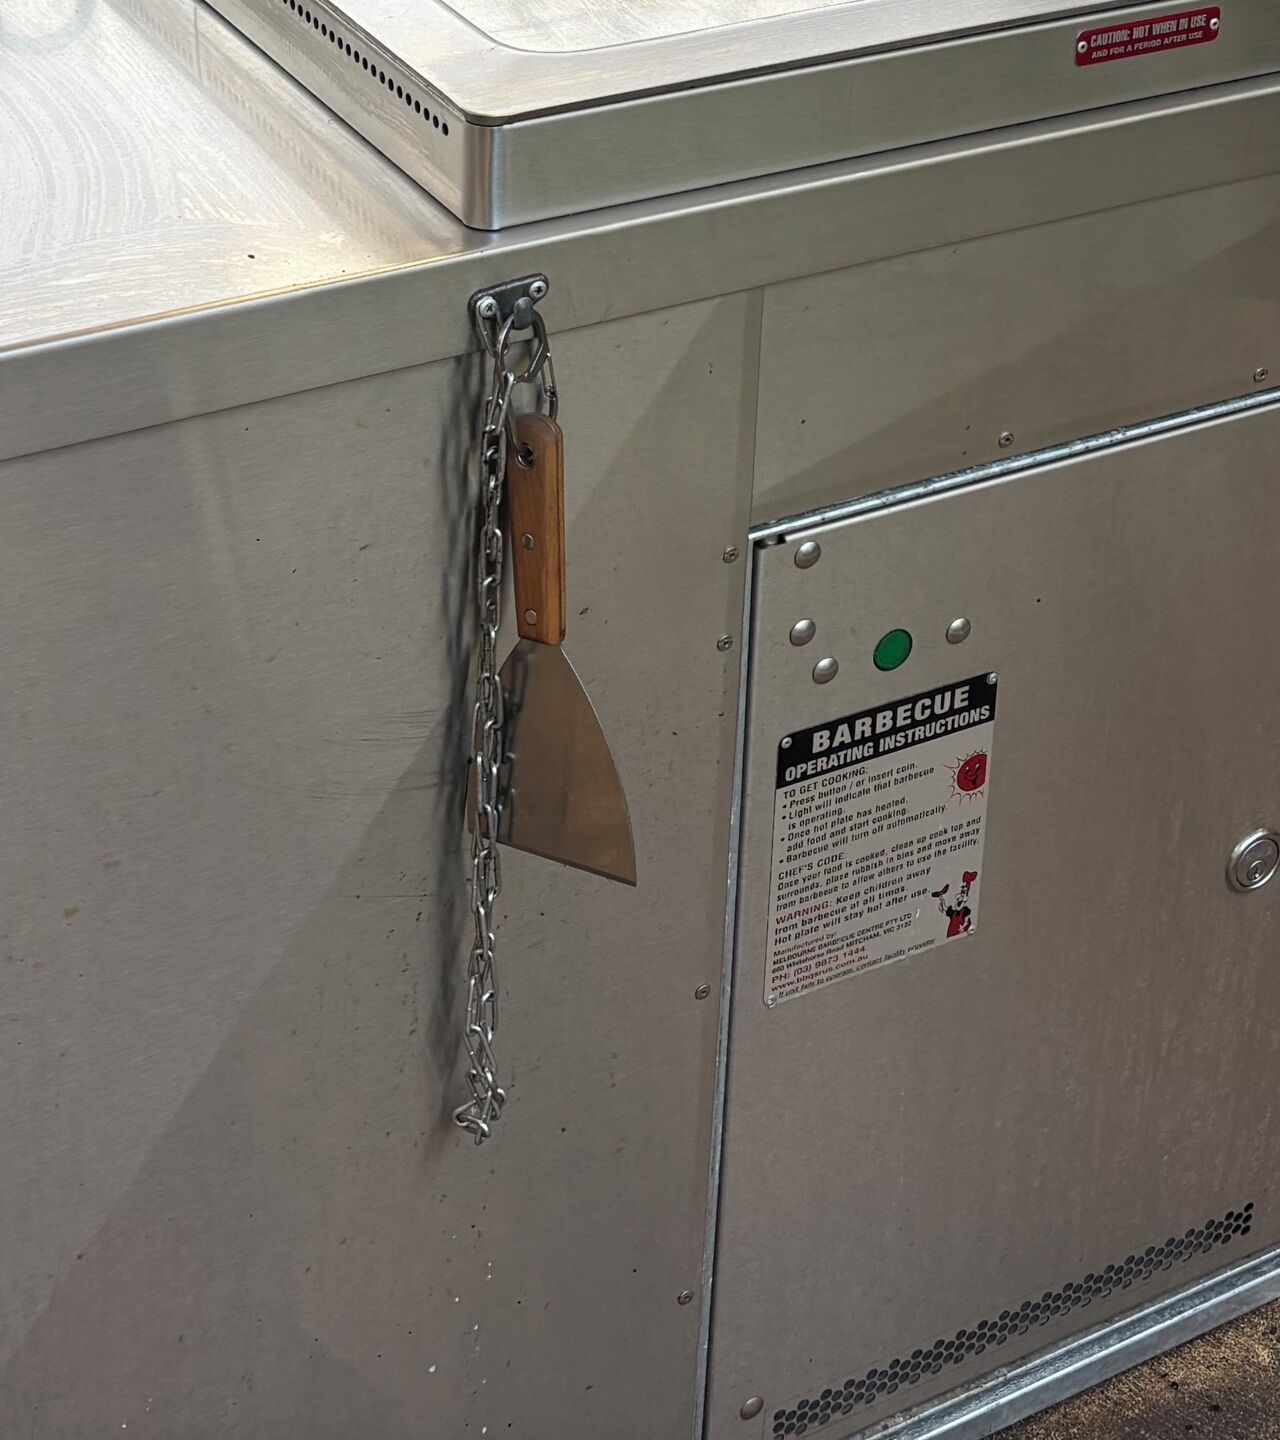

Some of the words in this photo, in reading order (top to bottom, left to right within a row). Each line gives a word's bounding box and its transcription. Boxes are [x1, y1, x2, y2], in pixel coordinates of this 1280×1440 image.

[1090, 29, 1131, 48] CAUTION:
[1132, 24, 1151, 39] HOT
[1152, 20, 1177, 35] WHEN
[1178, 17, 1190, 30] IN
[1190, 13, 1208, 28] USE
[1091, 49, 1108, 59] AND
[1109, 46, 1125, 56] FOR
[1126, 44, 1133, 52] A
[1134, 38, 1162, 51] PERIOD
[1163, 34, 1187, 45] AFTER
[1188, 30, 1204, 40] USE
[812, 685, 970, 754] BARBECUE
[785, 742, 874, 782] OPERATING
[879, 704, 991, 753] INSTRUCTIONS
[783, 789, 795, 799] TO
[799, 781, 818, 794] GET
[821, 765, 868, 788] COOKING:
[789, 793, 814, 809] Press
[818, 783, 846, 799] button
[856, 779, 864, 787] or
[868, 768, 893, 783] insert
[789, 805, 811, 820] Light
[815, 799, 831, 811] will
[835, 786, 870, 804] indicate
[874, 779, 890, 791] that
[894, 765, 934, 785] barbecue
[786, 842, 828, 863] Barbecue
[832, 836, 847, 847] will
[852, 829, 868, 841] turn
[872, 825, 883, 834] off
[787, 840, 803, 852] add
[807, 833, 826, 845] food
[830, 826, 845, 838] and
[849, 819, 868, 831] start
[788, 827, 809, 841] Once
[814, 822, 827, 832] hot
[831, 813, 853, 828] plate
[856, 807, 871, 818] has
[788, 821, 795, 830] is
[778, 877, 798, 891] Once
[802, 871, 820, 883] your
[824, 863, 841, 875] food
[845, 859, 852, 867] is
[891, 839, 913, 852] clean
[917, 835, 926, 844] up
[929, 827, 947, 839] cook
[951, 822, 963, 833] top
[966, 816, 980, 827] and
[778, 862, 813, 880] CHEF'S
[826, 871, 848, 885] place
[852, 859, 883, 876] rubbish
[886, 856, 893, 864] in
[896, 849, 913, 861] bins
[917, 843, 931, 853] and
[935, 835, 956, 847] move
[959, 827, 979, 840] away
[776, 899, 795, 911] from
[799, 884, 838, 904] barbecue
[842, 881, 849, 889] to
[852, 872, 874, 885] allow
[878, 863, 903, 877] others
[906, 859, 914, 867] to
[934, 848, 946, 857] the
[776, 899, 832, 925] WARNING:
[836, 890, 860, 905] Keep
[864, 875, 902, 895] children
[906, 867, 930, 881] away
[774, 934, 790, 945] Hot
[795, 924, 819, 940] plate
[823, 917, 840, 928] will
[844, 909, 863, 923] stay
[867, 903, 881, 913] hot
[886, 893, 908, 907] after
[775, 921, 797, 935] from
[801, 905, 846, 926] barbecue
[850, 901, 858, 909] at
[863, 895, 874, 905] all
[772, 971, 789, 983] PH:
